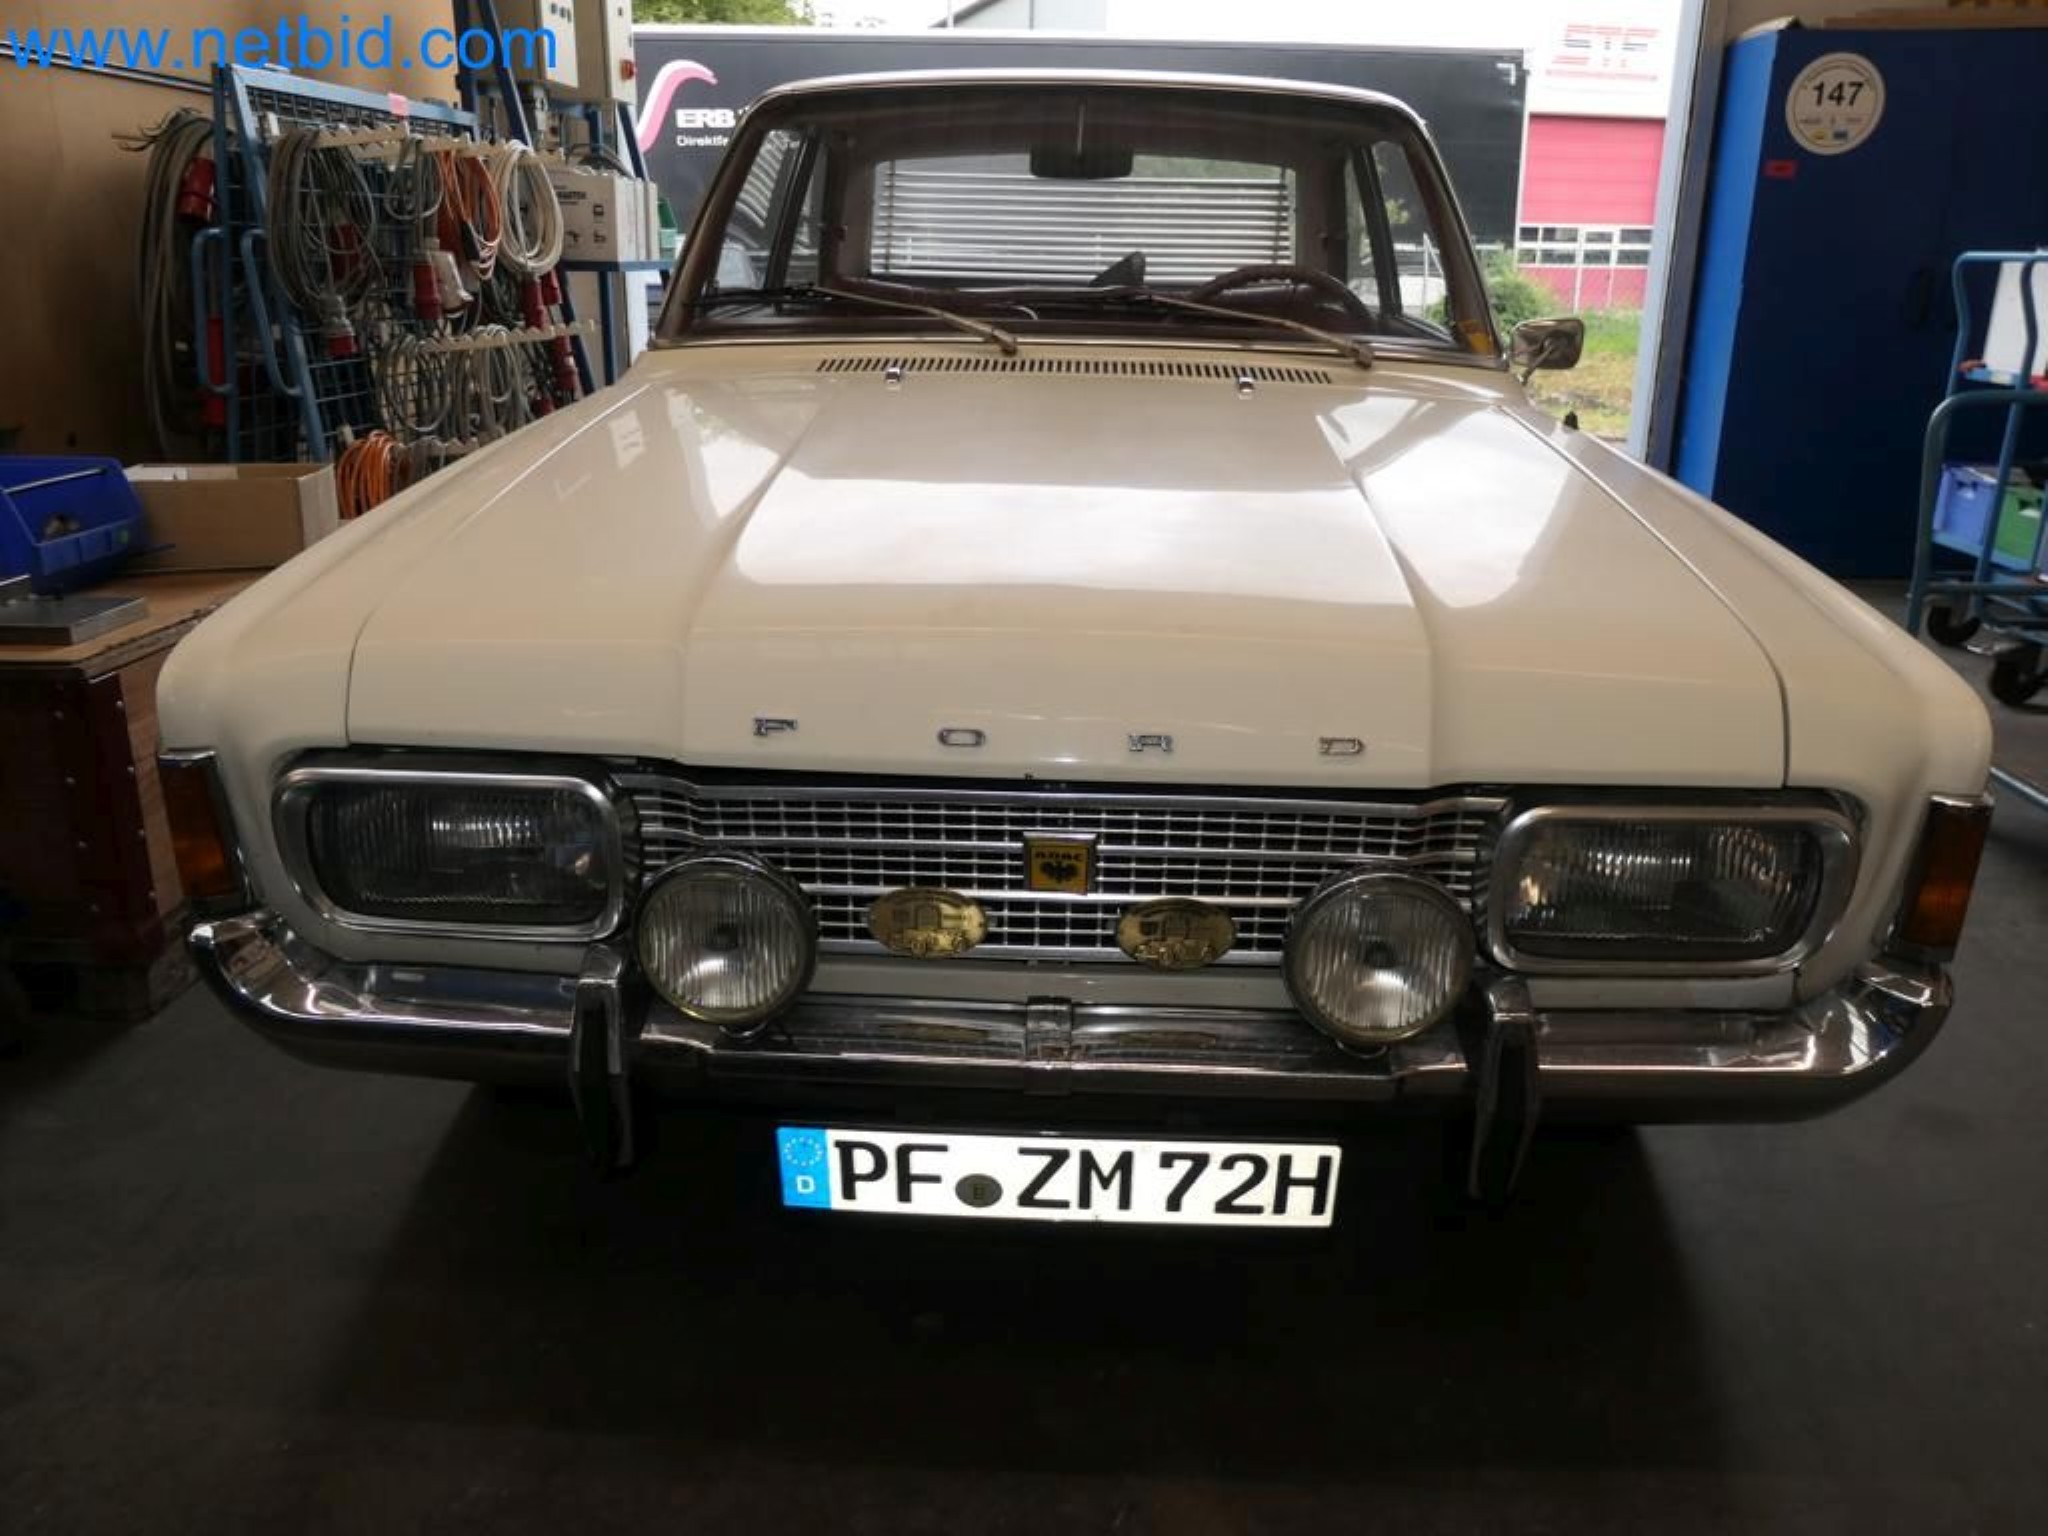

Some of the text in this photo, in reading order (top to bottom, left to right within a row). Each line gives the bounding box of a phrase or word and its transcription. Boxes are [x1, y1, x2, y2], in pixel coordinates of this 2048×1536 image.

[1812, 80, 1865, 107] 147
[752, 716, 1366, 758] FORD
[796, 1139, 1334, 1217] D PF ZM 72H
